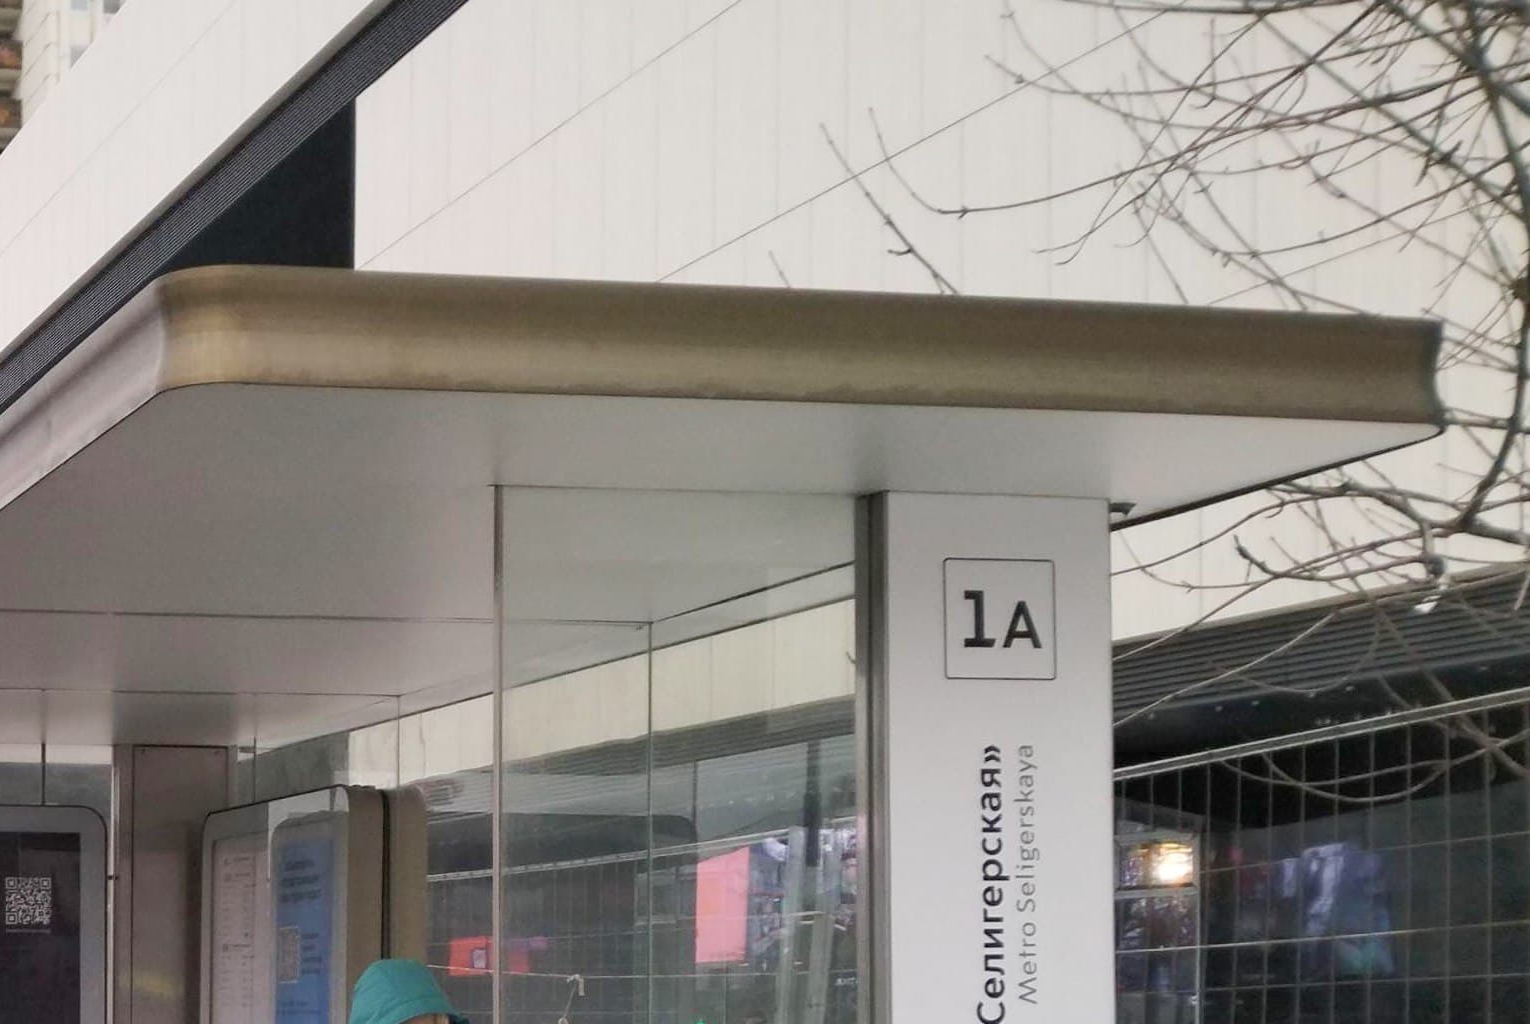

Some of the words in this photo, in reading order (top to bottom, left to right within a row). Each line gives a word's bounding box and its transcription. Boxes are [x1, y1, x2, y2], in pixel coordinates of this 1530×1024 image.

[963, 589, 1043, 649] 1А
[1014, 744, 1040, 913] Seligerskaya
[1018, 921, 1038, 1005] Metro
